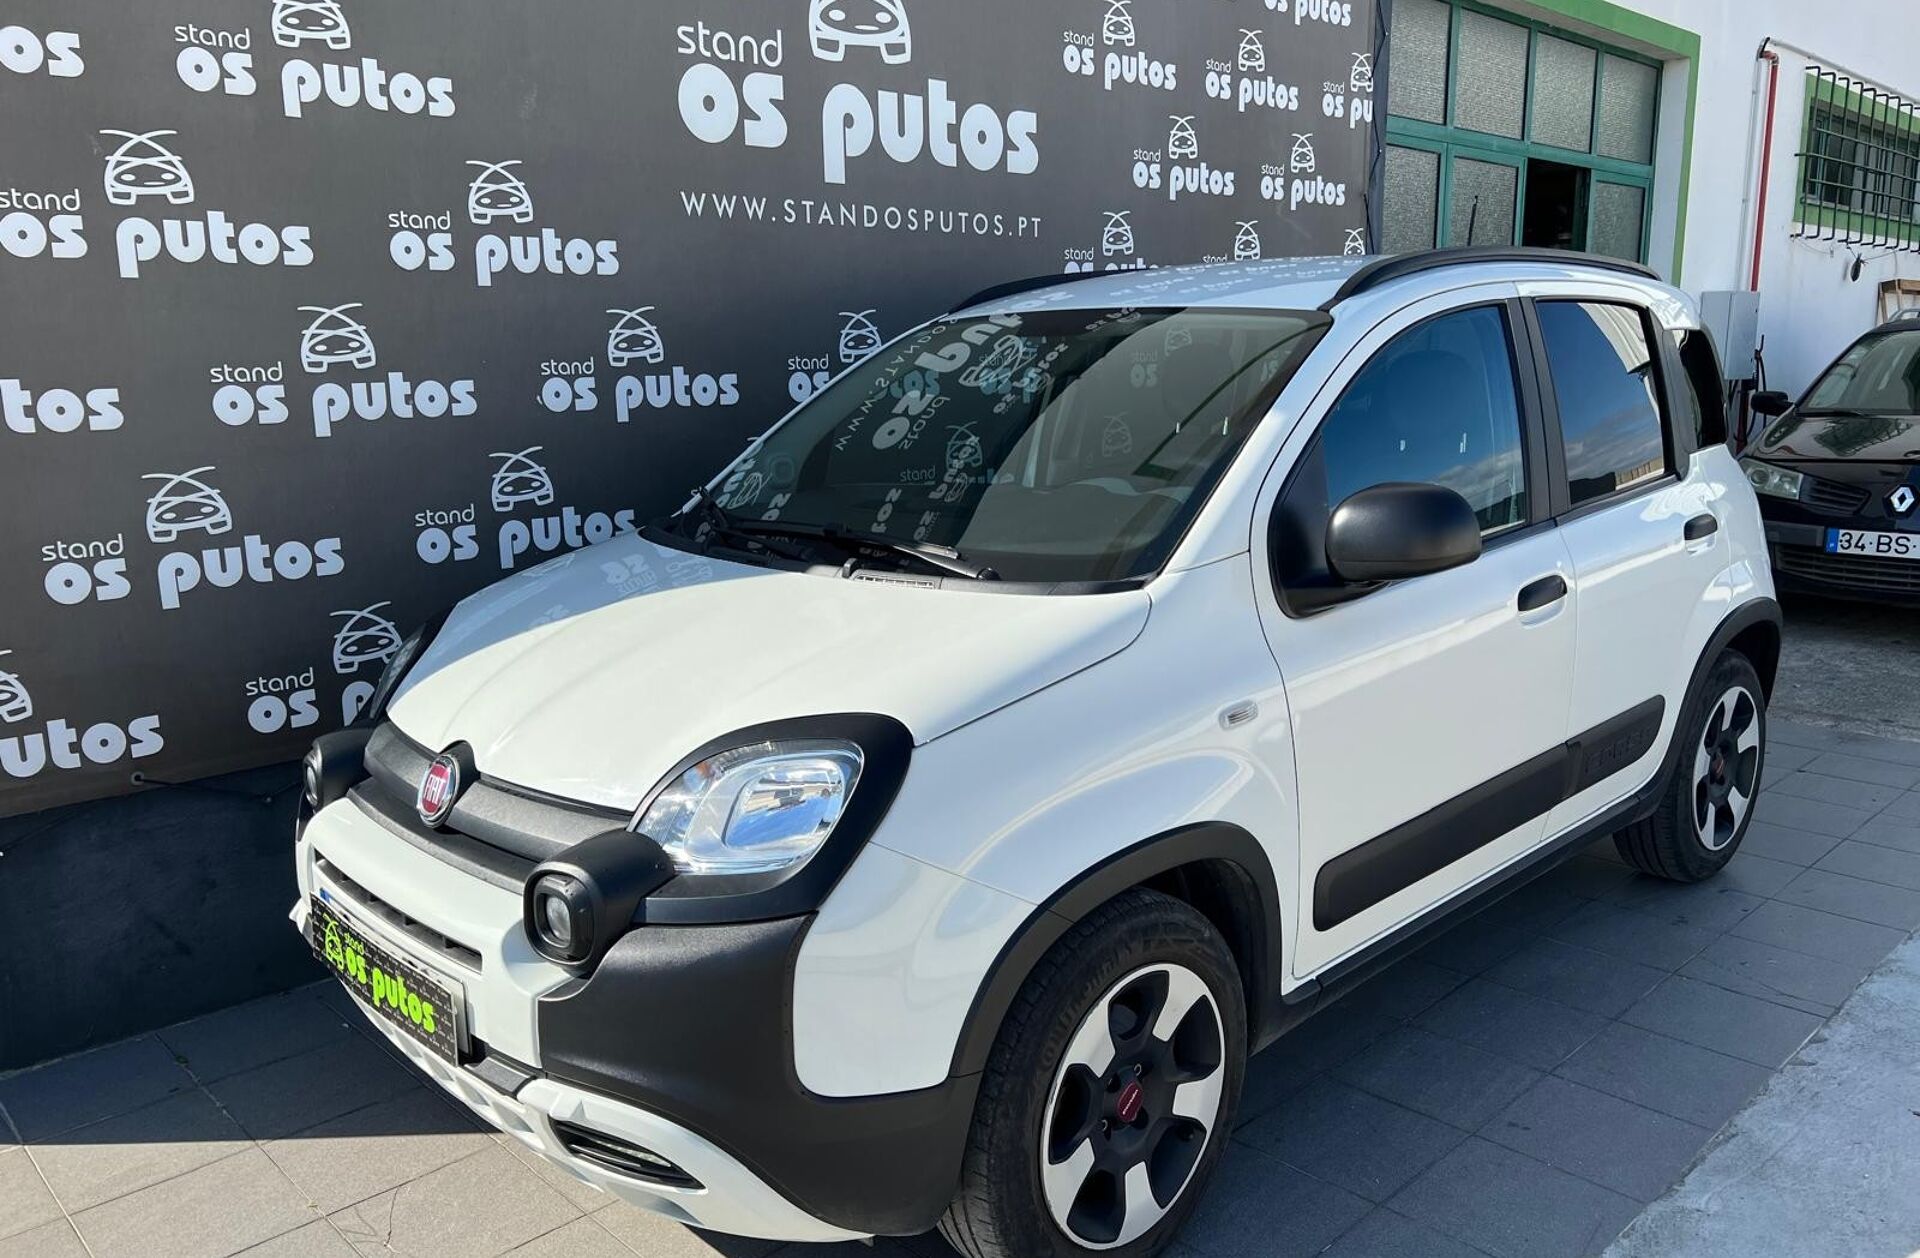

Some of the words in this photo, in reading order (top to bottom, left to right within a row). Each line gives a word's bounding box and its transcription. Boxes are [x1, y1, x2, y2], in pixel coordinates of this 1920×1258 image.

[1295, 0, 1351, 26] putos
[0, 26, 84, 77] os
[175, 24, 250, 49] stand
[677, 21, 783, 67] stand
[1064, 31, 1094, 47] stand
[1063, 45, 1094, 75] os
[1105, 52, 1176, 90] putos
[1206, 59, 1231, 73] stand
[177, 46, 256, 95] os
[282, 58, 455, 117] putos
[1206, 72, 1231, 99] os
[1239, 76, 1298, 112] putos
[1323, 82, 1344, 95] stand
[1323, 94, 1344, 117] os
[678, 63, 787, 147] os
[823, 79, 1038, 184] putos
[1134, 149, 1160, 164] stand
[1262, 164, 1284, 177] stand
[1133, 162, 1160, 188] os
[1170, 163, 1234, 200] putos
[1261, 176, 1284, 200] os
[1291, 176, 1345, 210] putos
[0, 189, 80, 211] stand
[680, 191, 1041, 238] WWW.STANDOSPUTOS.PT
[389, 211, 450, 230] stand
[0, 212, 87, 258] os
[116, 211, 313, 278] putos
[390, 231, 455, 270] os
[476, 228, 619, 286] putos
[1064, 247, 1094, 260] stand
[210, 361, 282, 382] stand
[541, 357, 594, 375] stand
[788, 354, 828, 370] stand
[213, 385, 288, 425] os
[313, 372, 477, 437] putos
[542, 377, 597, 412] os
[616, 366, 739, 422] putos
[415, 504, 475, 526] stand
[42, 534, 123, 561] stand
[417, 525, 479, 563] os
[499, 506, 635, 569] putos
[44, 558, 131, 604] os
[157, 535, 344, 609] putos
[246, 668, 314, 696] stand
[248, 690, 319, 733] os
[423, 774, 446, 804] FIAT
[345, 946, 367, 985] os
[372, 966, 436, 1033] putos
